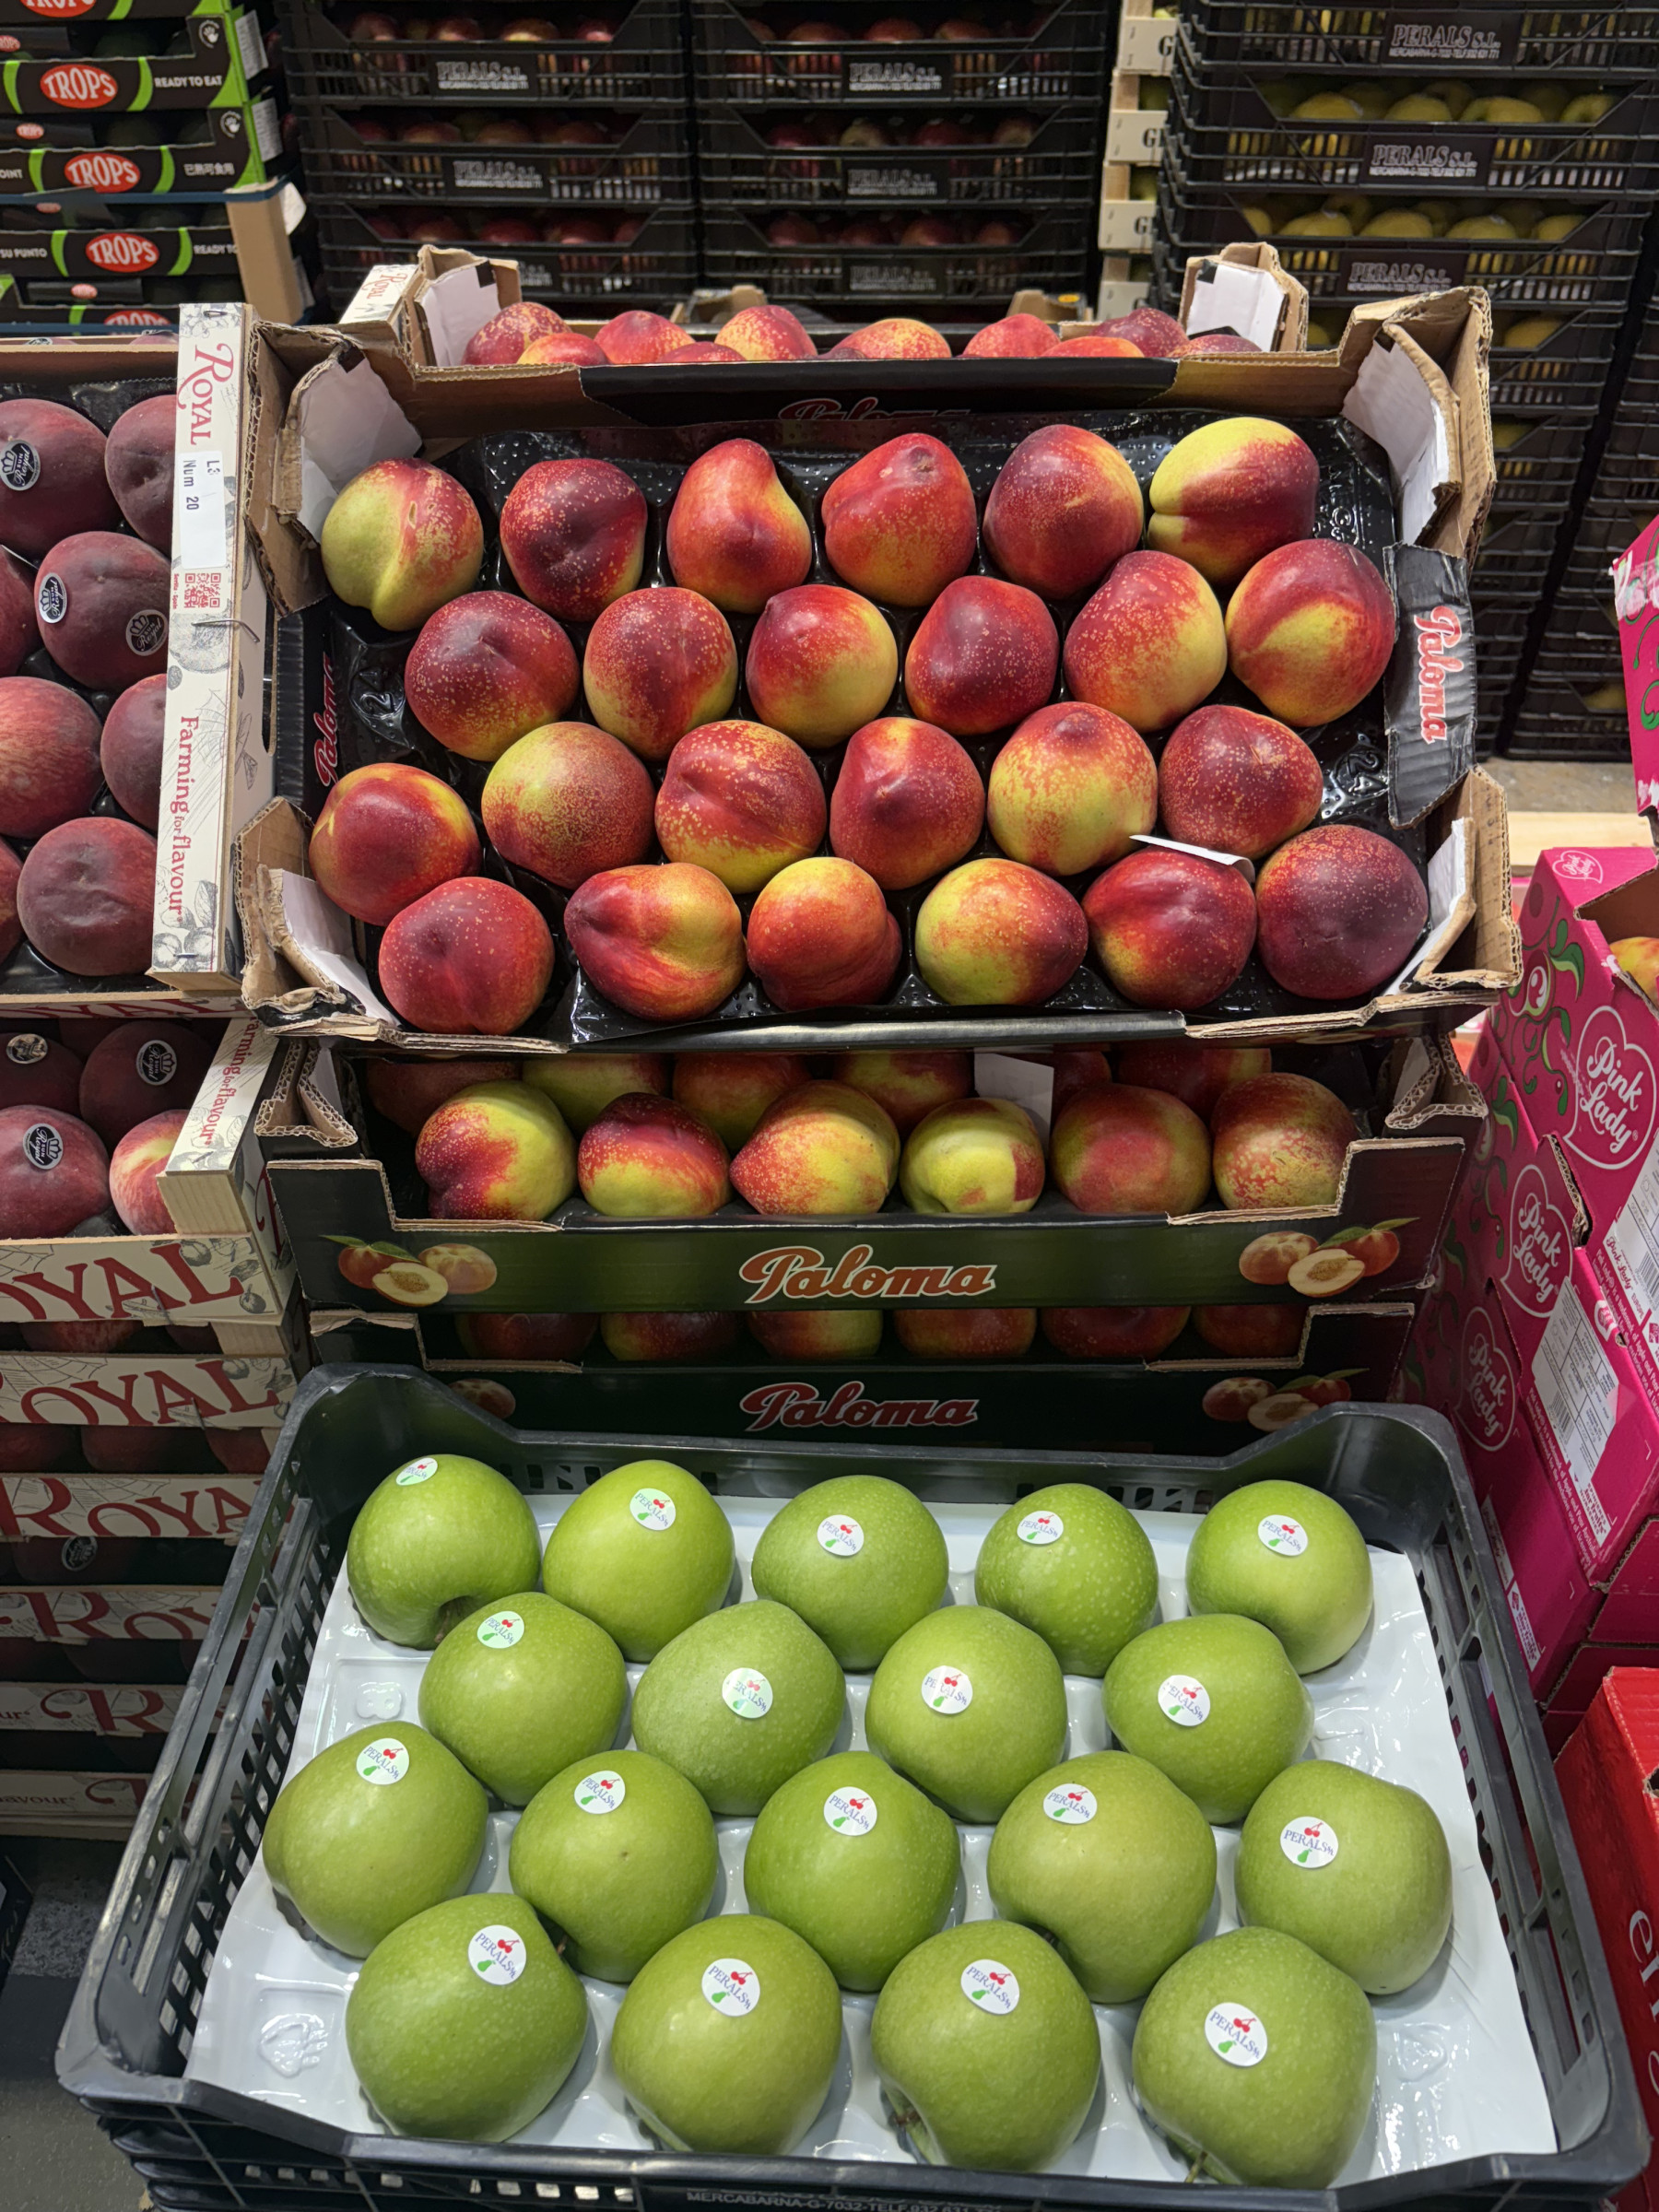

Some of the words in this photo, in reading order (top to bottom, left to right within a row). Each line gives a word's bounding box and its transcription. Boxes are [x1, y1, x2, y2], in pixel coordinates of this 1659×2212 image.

[1391, 24, 1472, 48] PERALS
[44, 66, 116, 100] TROPS
[154, 77, 187, 88] READY
[188, 77, 203, 88] TO
[205, 76, 223, 87] EAT
[67, 155, 138, 187] TROPS
[1371, 144, 1450, 167] PERALS
[14, 248, 48, 258] PUNTO
[89, 236, 158, 265] TROPS
[194, 244, 226, 254] READY
[177, 343, 234, 446] ROYAL
[14, 444, 34, 486] Royal
[183, 460, 197, 488] Num
[186, 496, 200, 511] 20
[50, 579, 62, 618] Royal
[137, 618, 162, 652] Royal
[1413, 604, 1464, 746] Paloma
[313, 650, 340, 788] Paloma
[170, 716, 199, 815] Farming
[173, 816, 183, 834] for
[222, 1016, 262, 1077] arming
[148, 1046, 159, 1080] Royal
[1586, 1035, 1643, 1112] Pink
[30, 1129, 48, 1164] Royal
[1519, 1193, 1562, 1268] Pink
[1606, 1236, 1622, 1266] Pink
[739, 1243, 998, 1305] Paloma
[1468, 1333, 1507, 1400] Pink
[0, 1359, 276, 1426] OYAL
[739, 1380, 980, 1433] Paloma
[635, 1492, 665, 1523] PERALS
[822, 1521, 853, 1547] PERALS
[1021, 1521, 1053, 1536] PERALS
[1262, 1521, 1296, 1549] PERALS
[1582, 1526, 1597, 1558] Australia
[485, 1618, 511, 1641] PERALS
[363, 1746, 396, 1774] PERALS
[582, 1777, 613, 1804] PERALS
[1047, 1792, 1084, 1815] PERALS
[829, 1795, 865, 1826] PERALS
[1283, 1829, 1327, 1853] PERALS
[475, 1932, 514, 1971] PERALS
[708, 1965, 748, 2006] PERALS
[967, 1965, 1006, 2006] PERALS
[1208, 2010, 1255, 2052] PERALS
